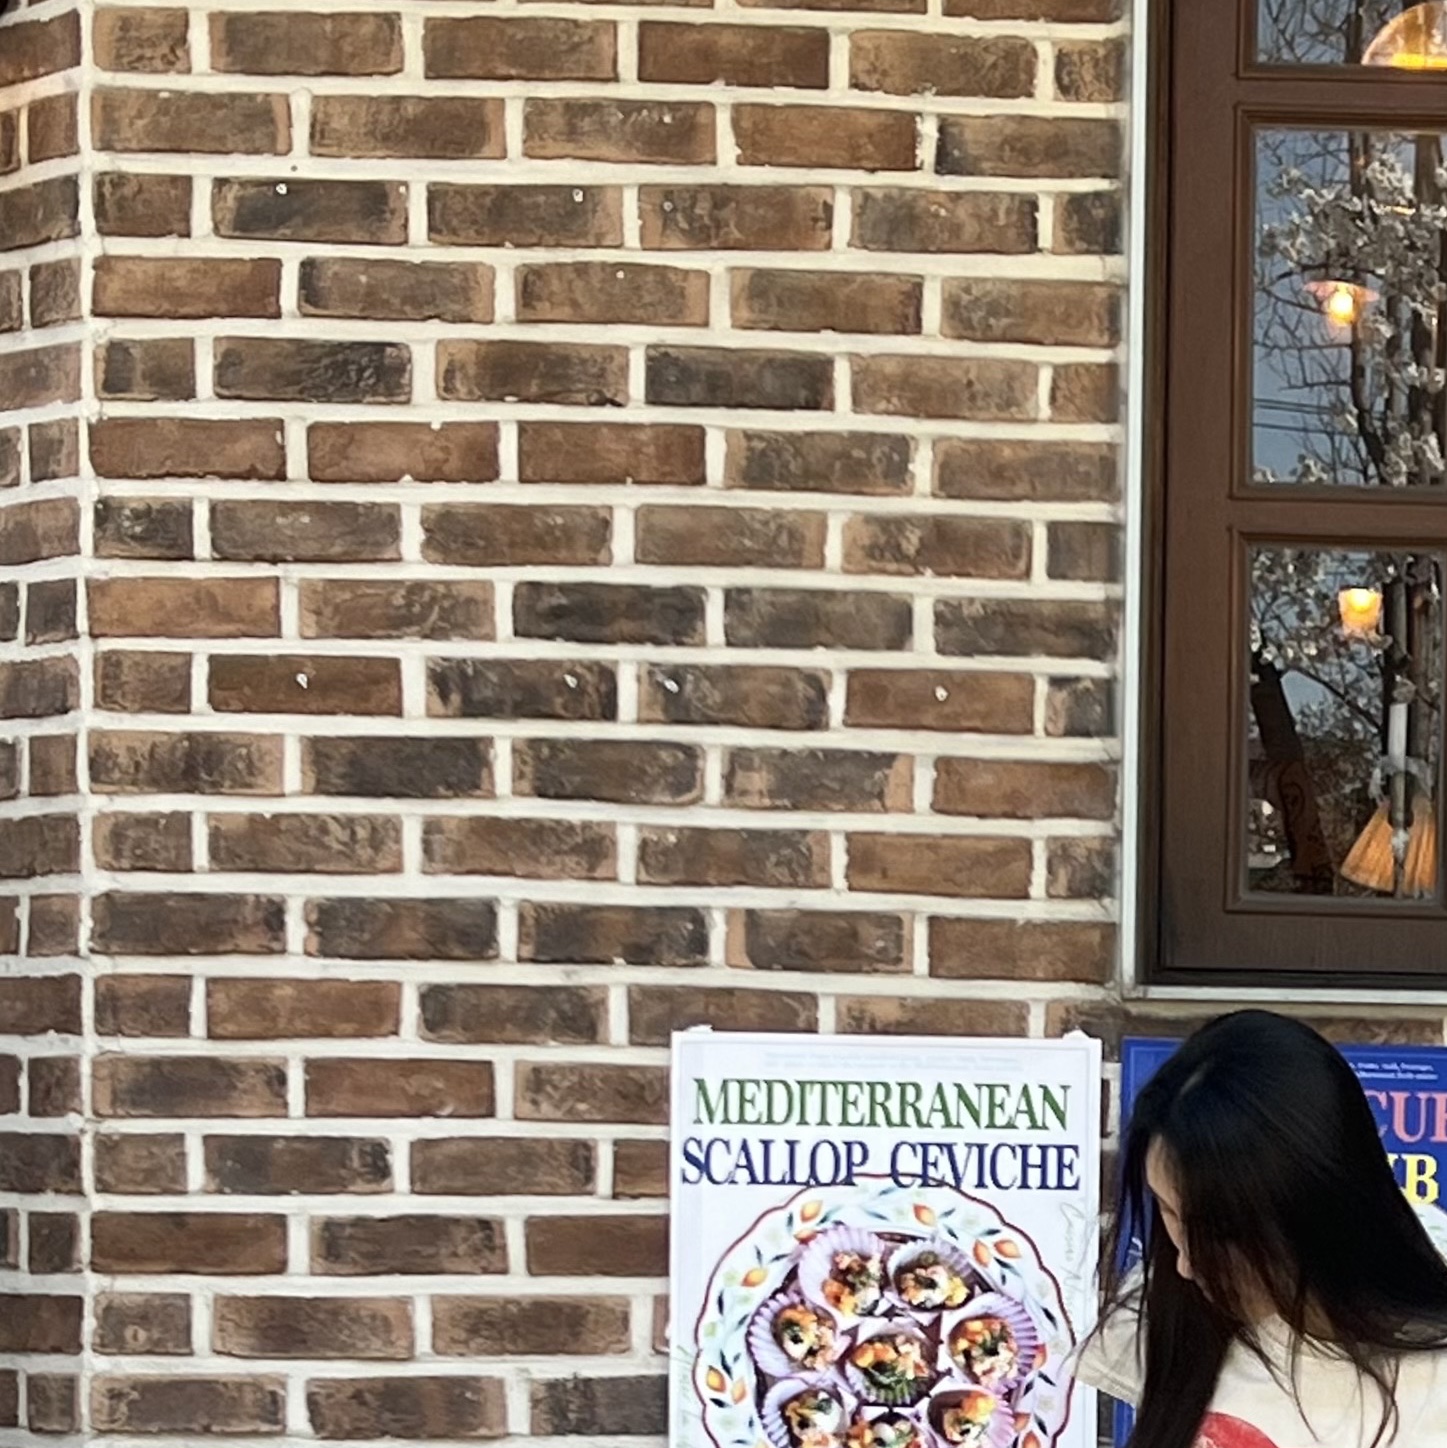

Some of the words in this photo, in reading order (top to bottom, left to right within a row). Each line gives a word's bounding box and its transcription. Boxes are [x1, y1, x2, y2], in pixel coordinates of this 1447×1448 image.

[692, 1078, 1072, 1131] MEDITERRANEAN
[681, 1137, 870, 1187] SCALLOP
[889, 1140, 1082, 1192] CEVICHE
